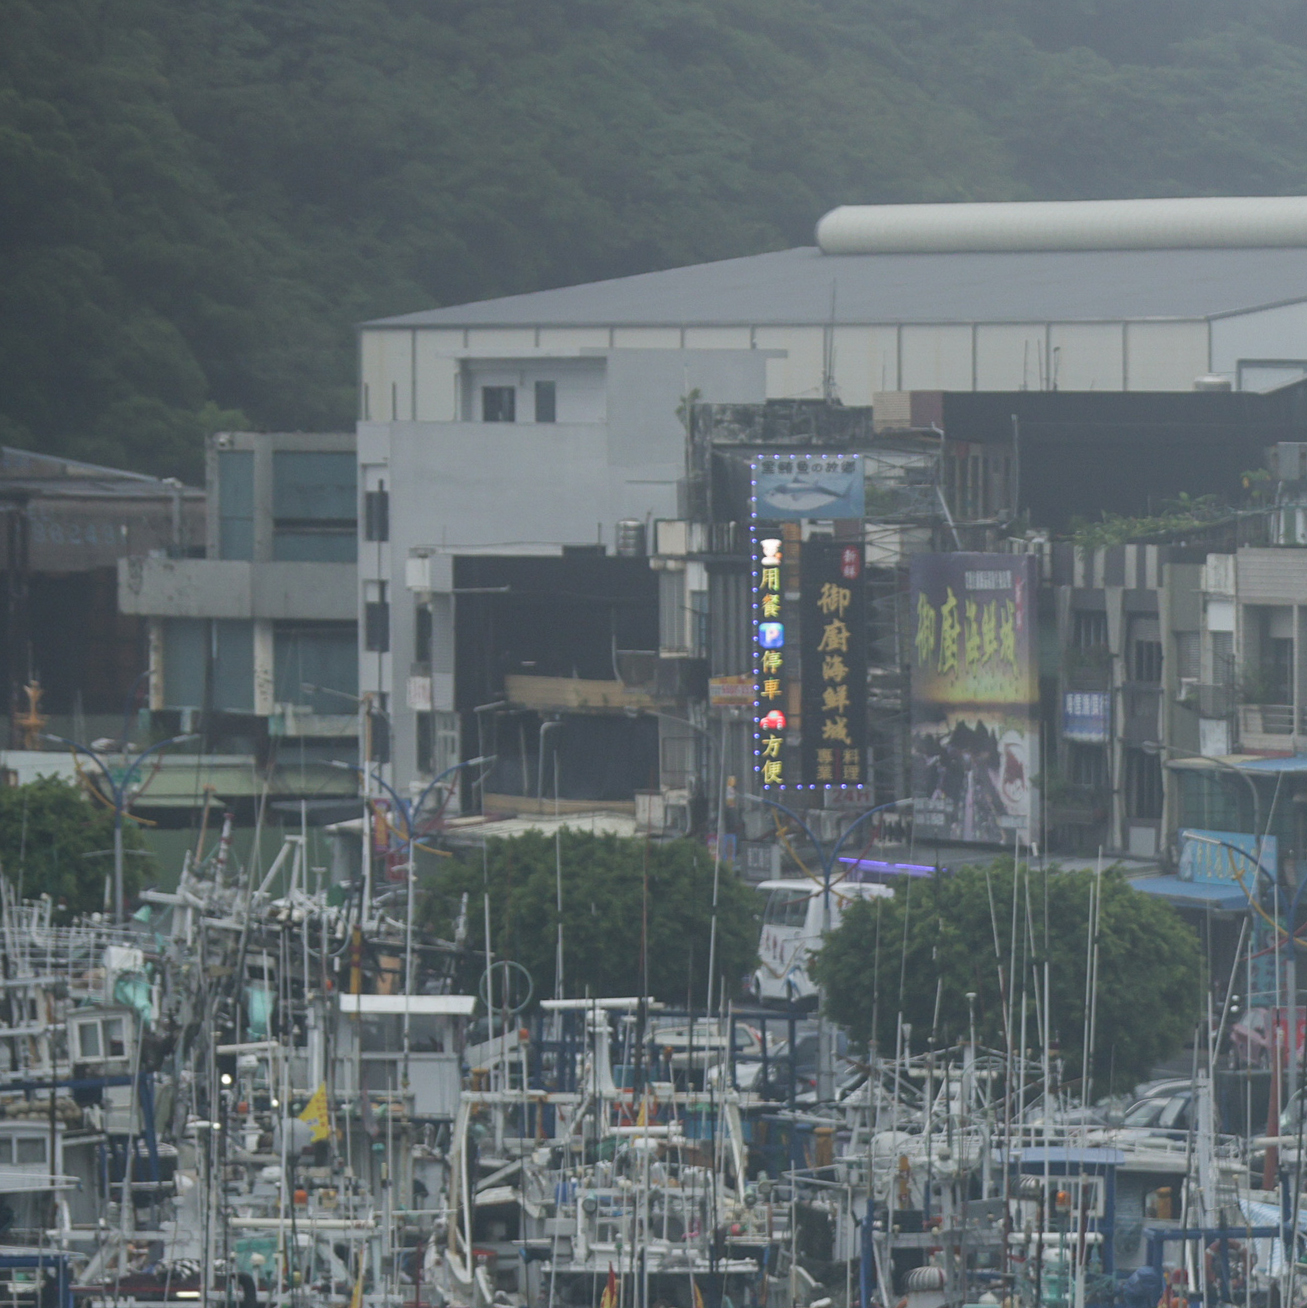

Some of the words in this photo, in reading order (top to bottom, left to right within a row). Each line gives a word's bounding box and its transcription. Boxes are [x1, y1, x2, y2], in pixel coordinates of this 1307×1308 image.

[759, 567, 781, 618] 用餐
[760, 650, 784, 701] 停車
[761, 733, 784, 785] 方便
